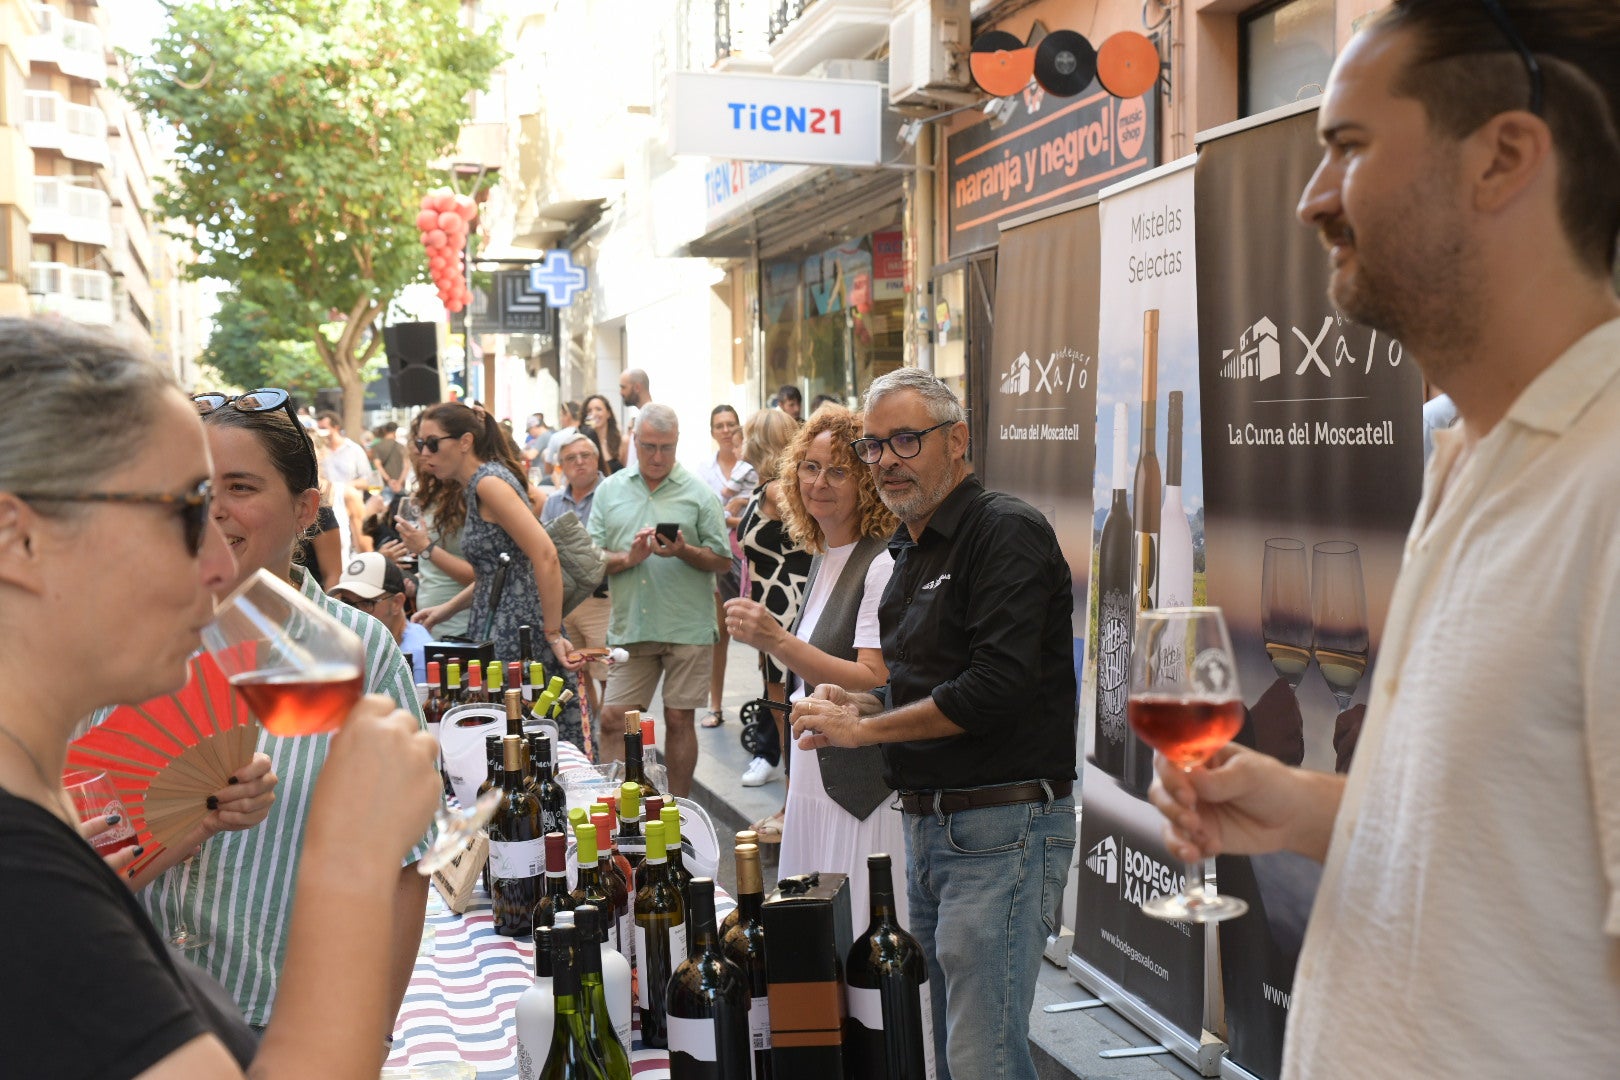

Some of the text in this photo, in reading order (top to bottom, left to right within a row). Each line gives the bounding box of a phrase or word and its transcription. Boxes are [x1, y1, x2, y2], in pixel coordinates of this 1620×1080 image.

[1119, 108, 1143, 128] music
[1121, 124, 1141, 144] shop
[955, 105, 1109, 208] naranja y negro!
[1131, 204, 1182, 244] Mistelas
[1128, 248, 1182, 284] Selectas
[1000, 423, 1079, 441] La Cuna del Moscatell
[1228, 420, 1394, 445] La Cuna del Moscatell
[1124, 846, 1186, 897] BODEGAS
[1100, 928, 1169, 981] www.bodegasxalo.com
